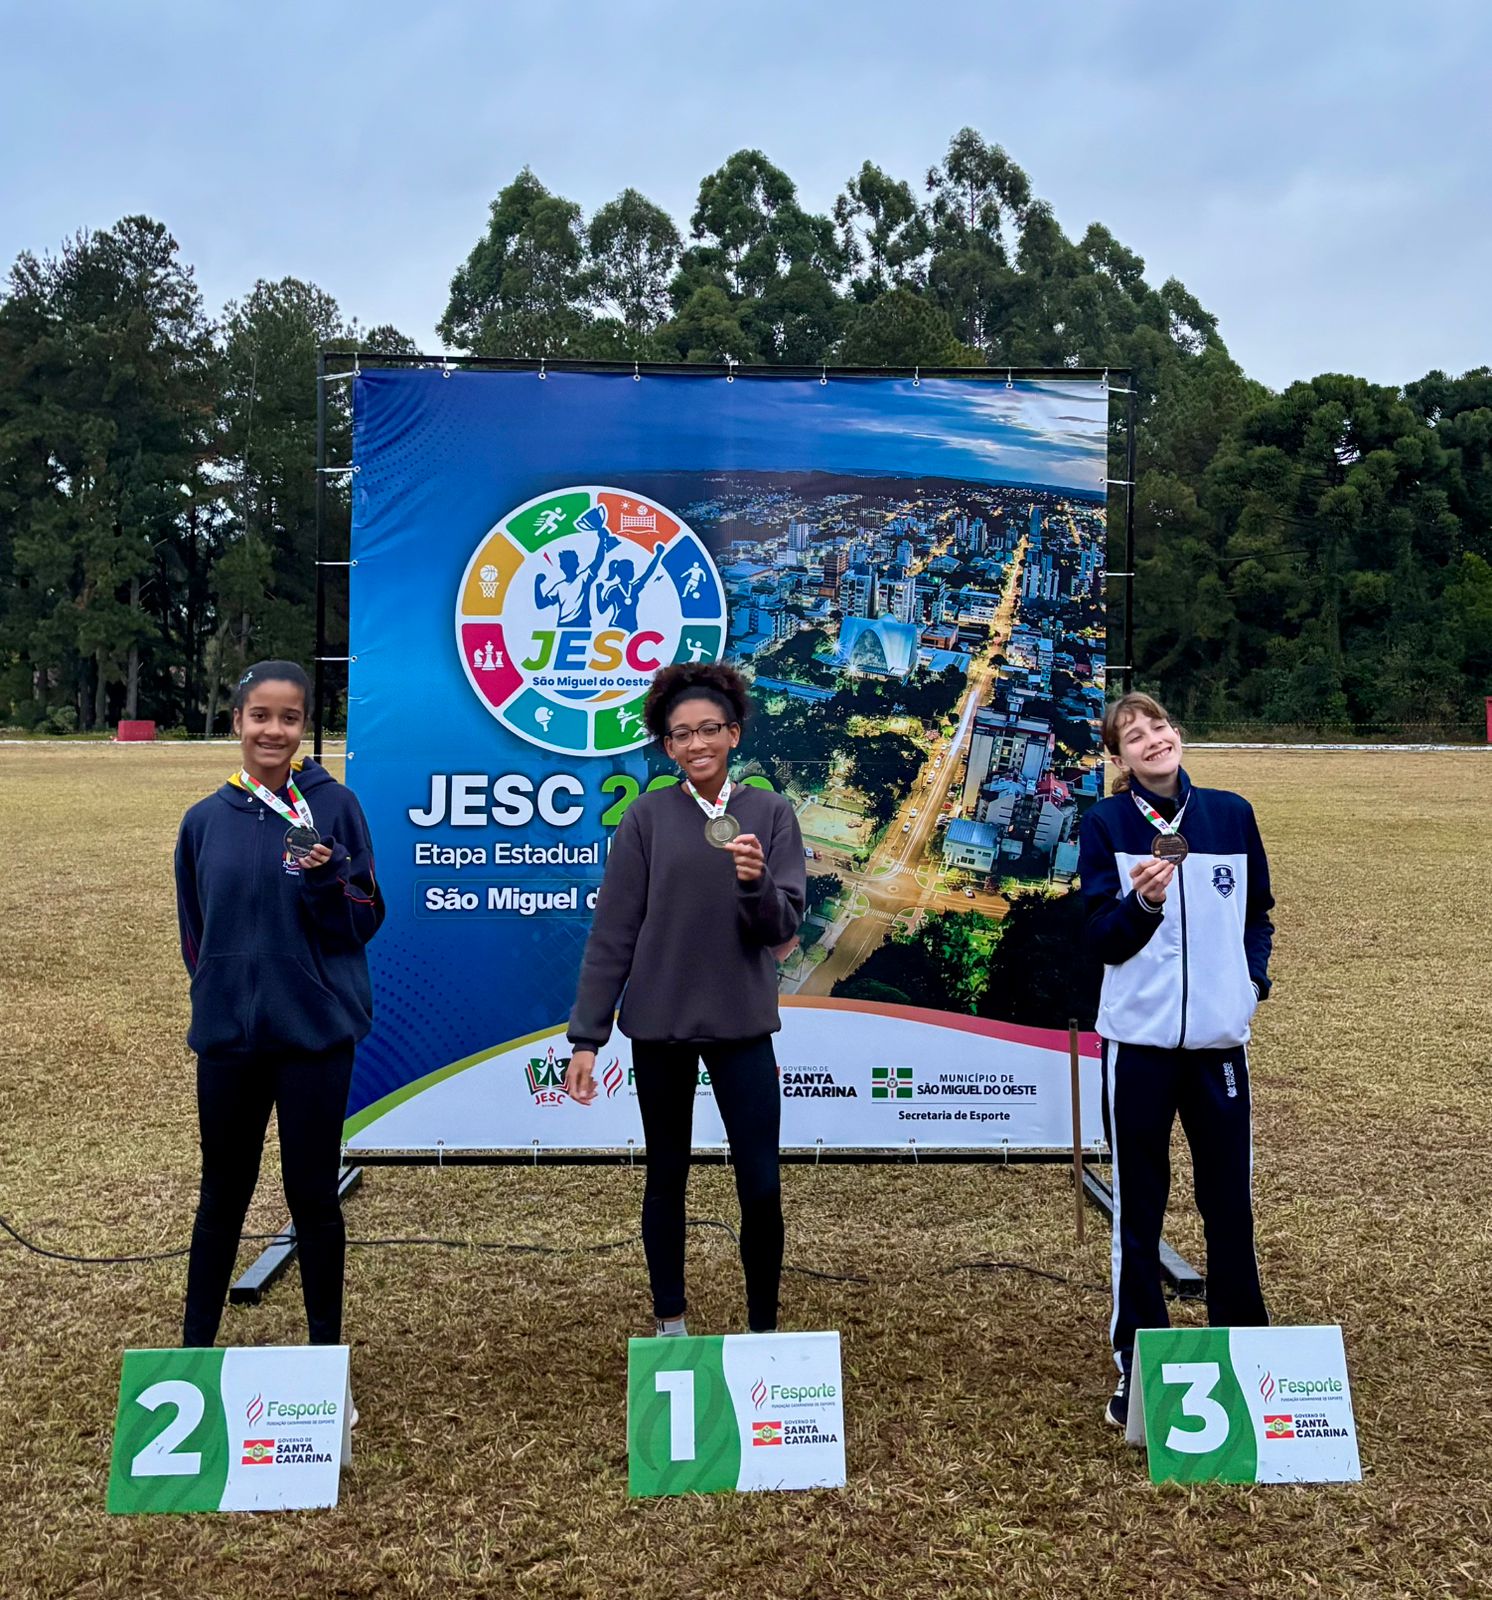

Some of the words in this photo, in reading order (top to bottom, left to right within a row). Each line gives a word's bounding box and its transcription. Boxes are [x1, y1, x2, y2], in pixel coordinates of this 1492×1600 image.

[521, 630, 665, 672] JESC
[533, 676, 555, 686] São
[557, 676, 597, 689] Miguel
[599, 677, 614, 686] do
[408, 775, 584, 827] JESC
[415, 843, 486, 869] Etapa
[495, 842, 598, 865] Estadual
[425, 887, 478, 911] São
[488, 887, 577, 915] Miguel
[783, 1073, 834, 1085] SANTA
[939, 1073, 997, 1083] MUNICÍPIO
[1000, 1074, 1014, 1083] DE
[783, 1086, 858, 1098] CATARINA
[917, 1083, 939, 1095] SÃO
[941, 1085, 982, 1095] MIGUEL
[983, 1085, 1000, 1095] DO
[1002, 1085, 1037, 1095] OESTE
[535, 1091, 566, 1105] JESC
[898, 1110, 952, 1120] Secretaria
[954, 1110, 968, 1120] de
[969, 1111, 1011, 1122] Esporte
[771, 1383, 836, 1402] Fesporte
[1278, 1377, 1342, 1396] Fesporte
[267, 1399, 337, 1420] Fesporte
[1161, 1362, 1230, 1454] 3
[655, 1370, 695, 1460] 1
[131, 1380, 205, 1476] 2
[784, 1425, 819, 1435] SANTA
[1295, 1419, 1329, 1428] SANTA
[784, 1434, 838, 1445] CATARINA
[1296, 1428, 1349, 1438] CATARINA
[276, 1444, 314, 1454] SANTA
[275, 1453, 333, 1464] CATARINA
